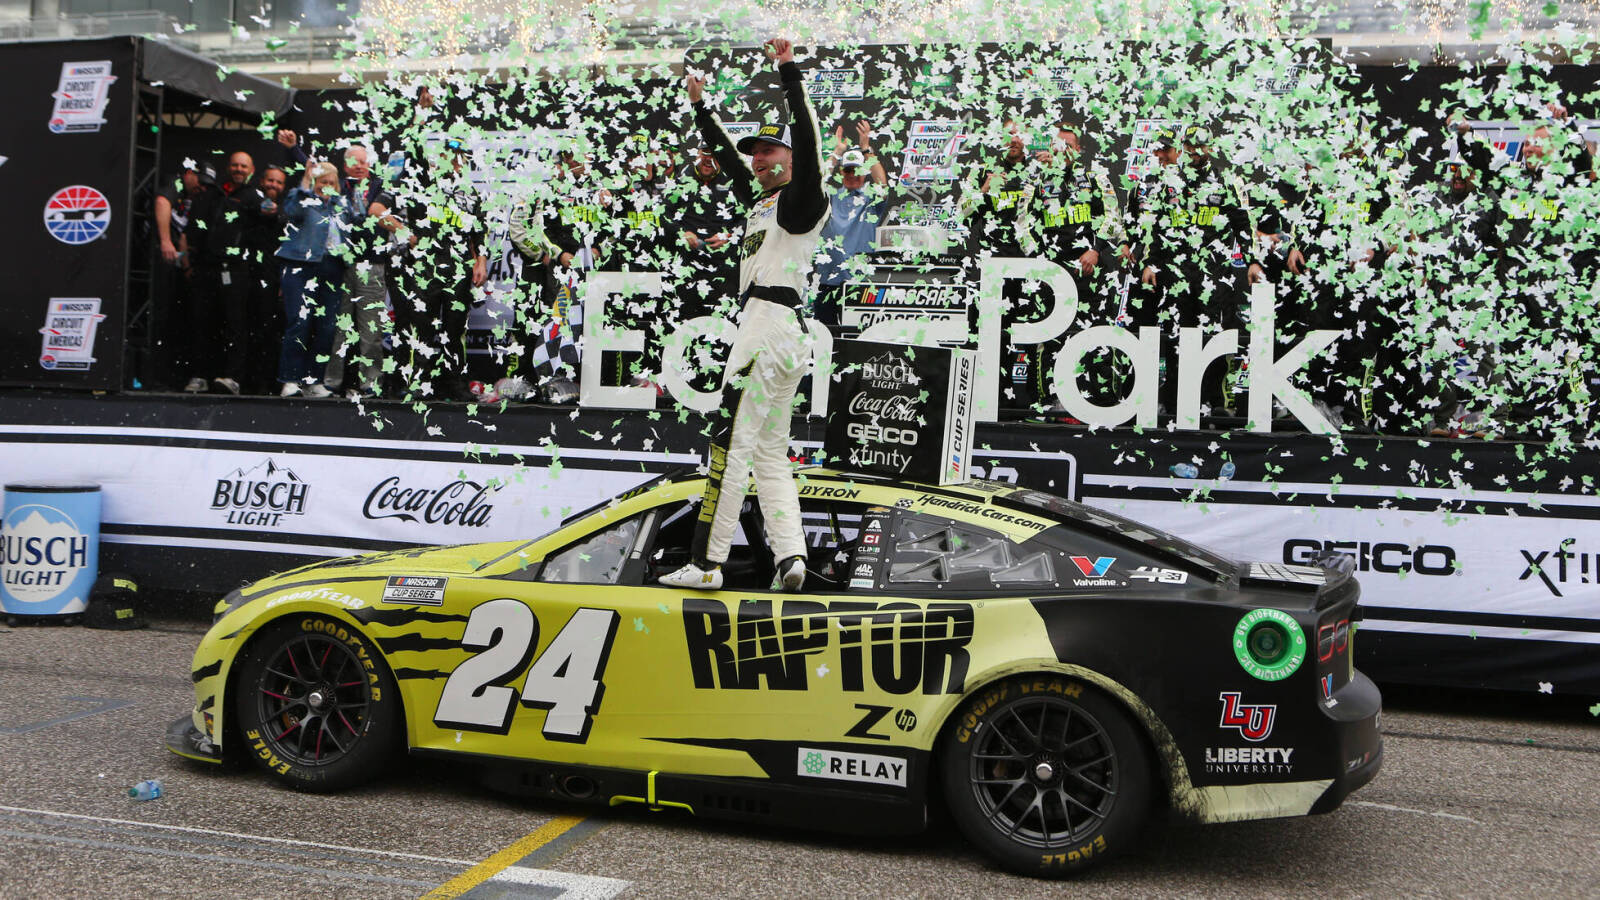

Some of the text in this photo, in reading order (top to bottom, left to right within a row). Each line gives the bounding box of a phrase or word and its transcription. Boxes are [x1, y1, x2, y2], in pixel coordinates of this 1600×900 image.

[871, 379, 902, 390] LIGHT
[848, 391, 922, 422] Coca-Cola
[952, 356, 970, 453] CUP SERIES
[847, 422, 918, 446] GEICO
[849, 443, 913, 474] xfinity
[210, 478, 310, 515] BUSCH
[362, 476, 504, 528] Coca-Cola
[801, 485, 861, 500] BYRON
[226, 510, 283, 527] LIGHT
[5, 569, 68, 586] LIGHT
[406, 576, 439, 588] NASCAR
[1072, 578, 1117, 588] Valvoline
[266, 586, 365, 610] GOODYEAR
[391, 588, 436, 600] CUP SERIES
[682, 597, 975, 697] RAPTOR
[433, 597, 621, 744] 24
[844, 703, 917, 741] Z hp
[1218, 691, 1278, 742] LU
[246, 728, 292, 776] EAGLE
[1205, 747, 1294, 764] LIBERTY
[829, 756, 904, 781] RELAY
[1205, 764, 1294, 774] UNIVERSITY
[1041, 833, 1107, 868] EAGLE
